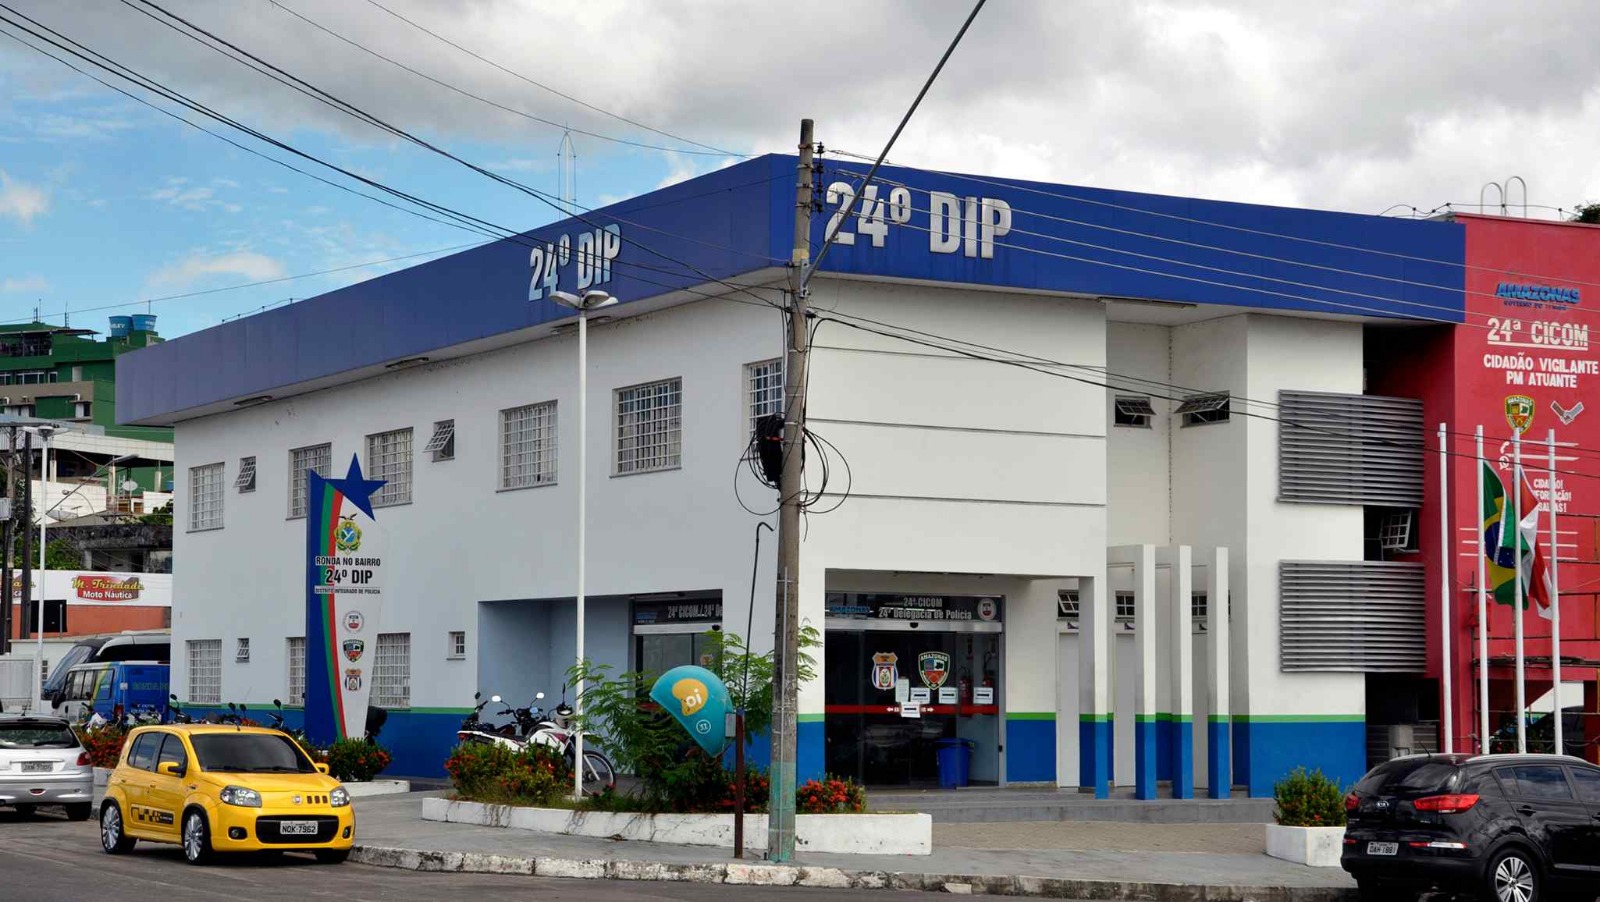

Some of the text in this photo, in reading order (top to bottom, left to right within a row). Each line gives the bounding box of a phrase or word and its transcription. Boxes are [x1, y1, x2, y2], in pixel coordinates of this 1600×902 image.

[824, 181, 1012, 259] 24º DIP
[528, 223, 621, 301] 24º DIP
[1495, 282, 1580, 304] AMAZONAS
[1530, 320, 1588, 347] CICOM
[1483, 352, 1599, 375] CIDADÃO VIGILANTE
[1506, 370, 1578, 389] PM ATUANTE
[315, 556, 381, 567] RONDA NO BAIRRO
[325, 568, 373, 585] 24º DIP
[83, 590, 133, 599] Moto Náutica
[917, 597, 943, 608] CICOM
[893, 607, 932, 620] Delegacia
[933, 608, 944, 619] de
